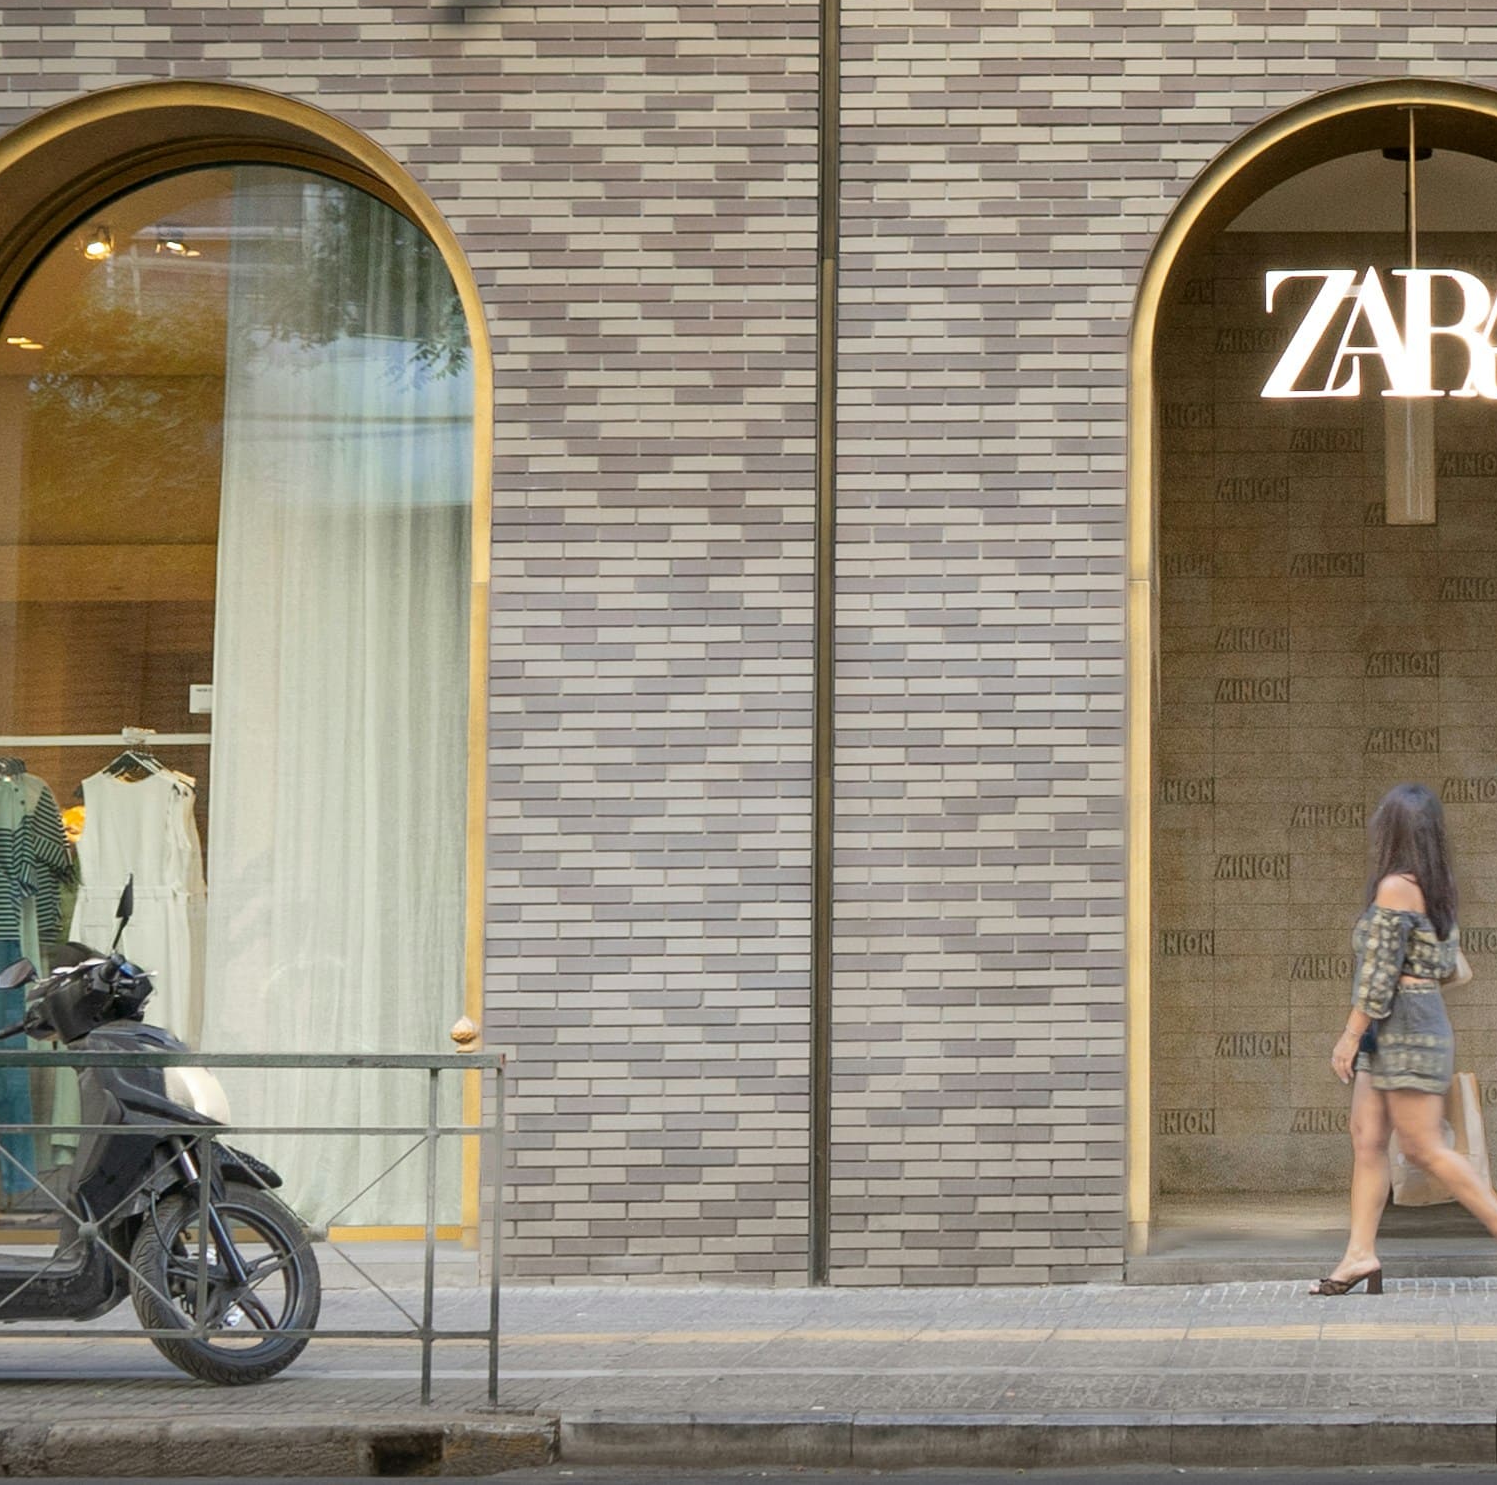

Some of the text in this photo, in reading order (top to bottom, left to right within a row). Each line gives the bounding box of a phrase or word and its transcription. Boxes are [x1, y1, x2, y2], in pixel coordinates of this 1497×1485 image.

[1215, 329, 1281, 351] MINIO
[1288, 428, 1363, 451] MINION
[1367, 652, 1438, 676] MINION
[1216, 679, 1289, 702] MINION
[1367, 728, 1438, 752] MINION
[1160, 778, 1214, 803] INION
[1291, 804, 1364, 827] MINION
[1216, 854, 1288, 878] MINION
[1160, 930, 1214, 954] INION
[1291, 956, 1353, 979] MINIO
[1216, 1032, 1290, 1057] MINION
[1160, 1110, 1214, 1134] INION
[1291, 1109, 1351, 1134] MINIO
